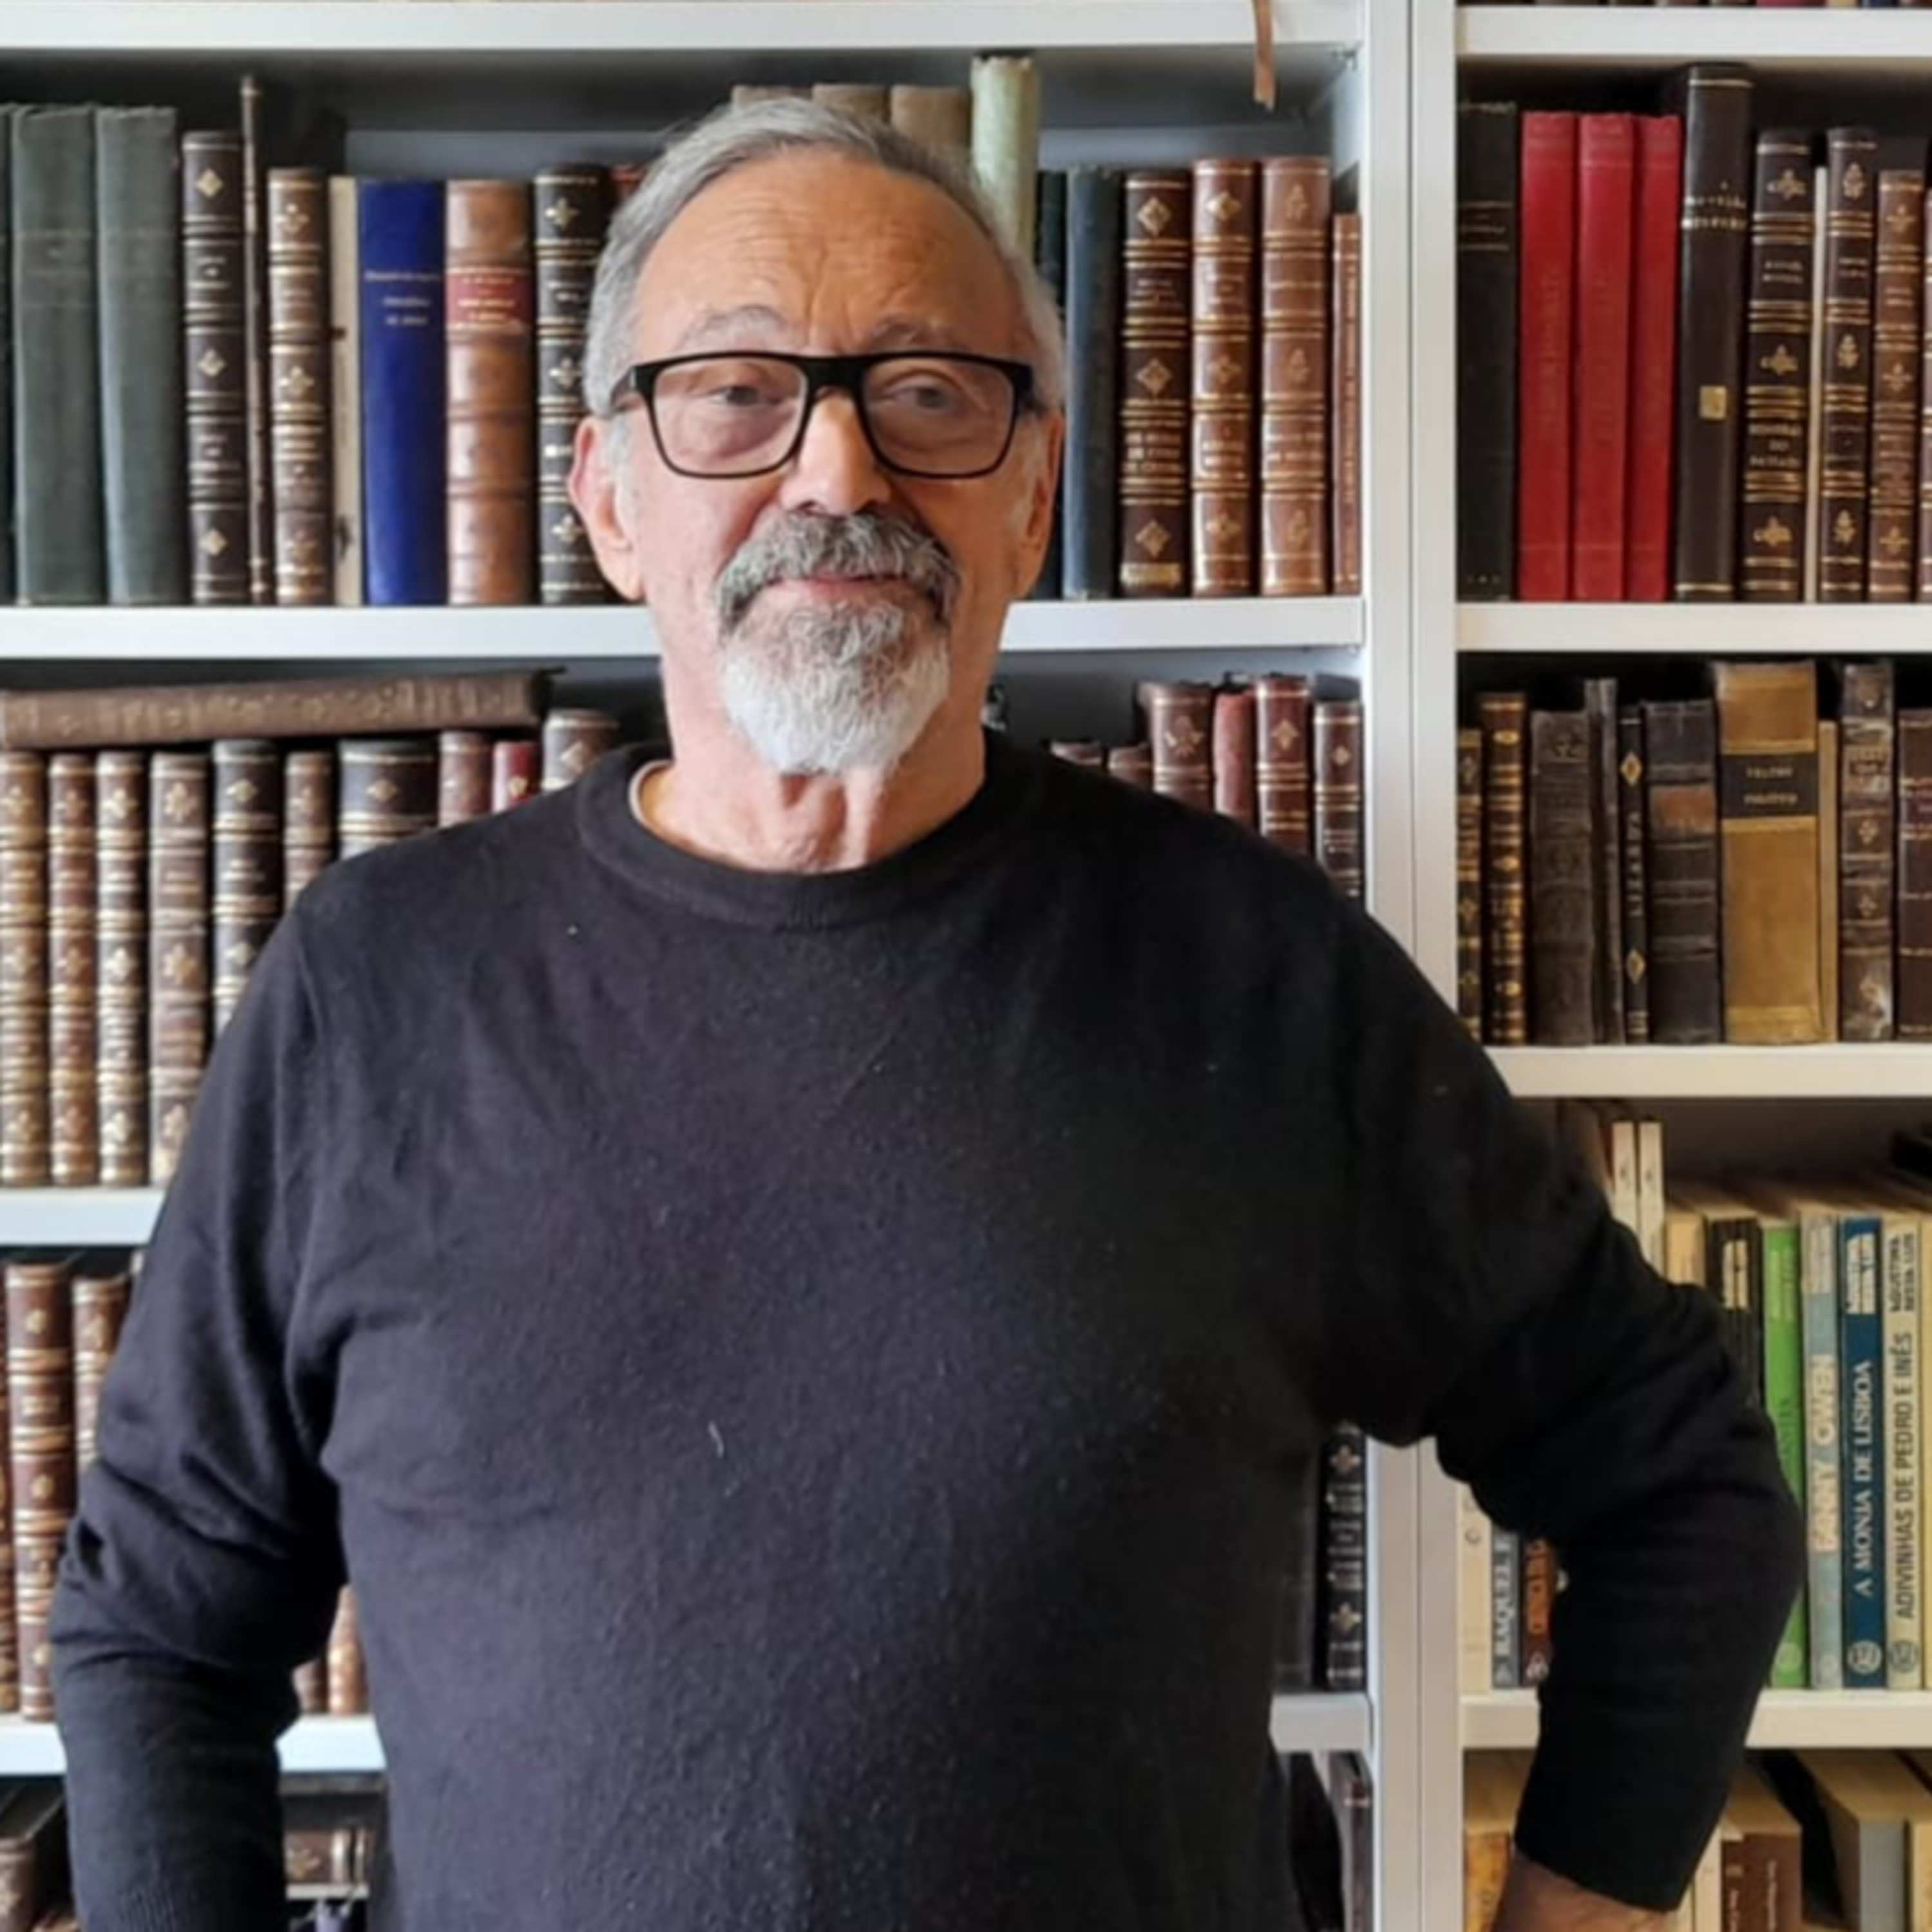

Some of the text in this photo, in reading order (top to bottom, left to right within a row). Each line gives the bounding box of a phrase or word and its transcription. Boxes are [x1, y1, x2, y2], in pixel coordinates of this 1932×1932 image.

[1813, 1358, 1838, 1551] FANNY OWEN
[1853, 1360, 1873, 1595] A MONJA DE LISBOA
[1889, 1332, 1915, 1620] ADIVINHAS DE PEDRO E INÊS
